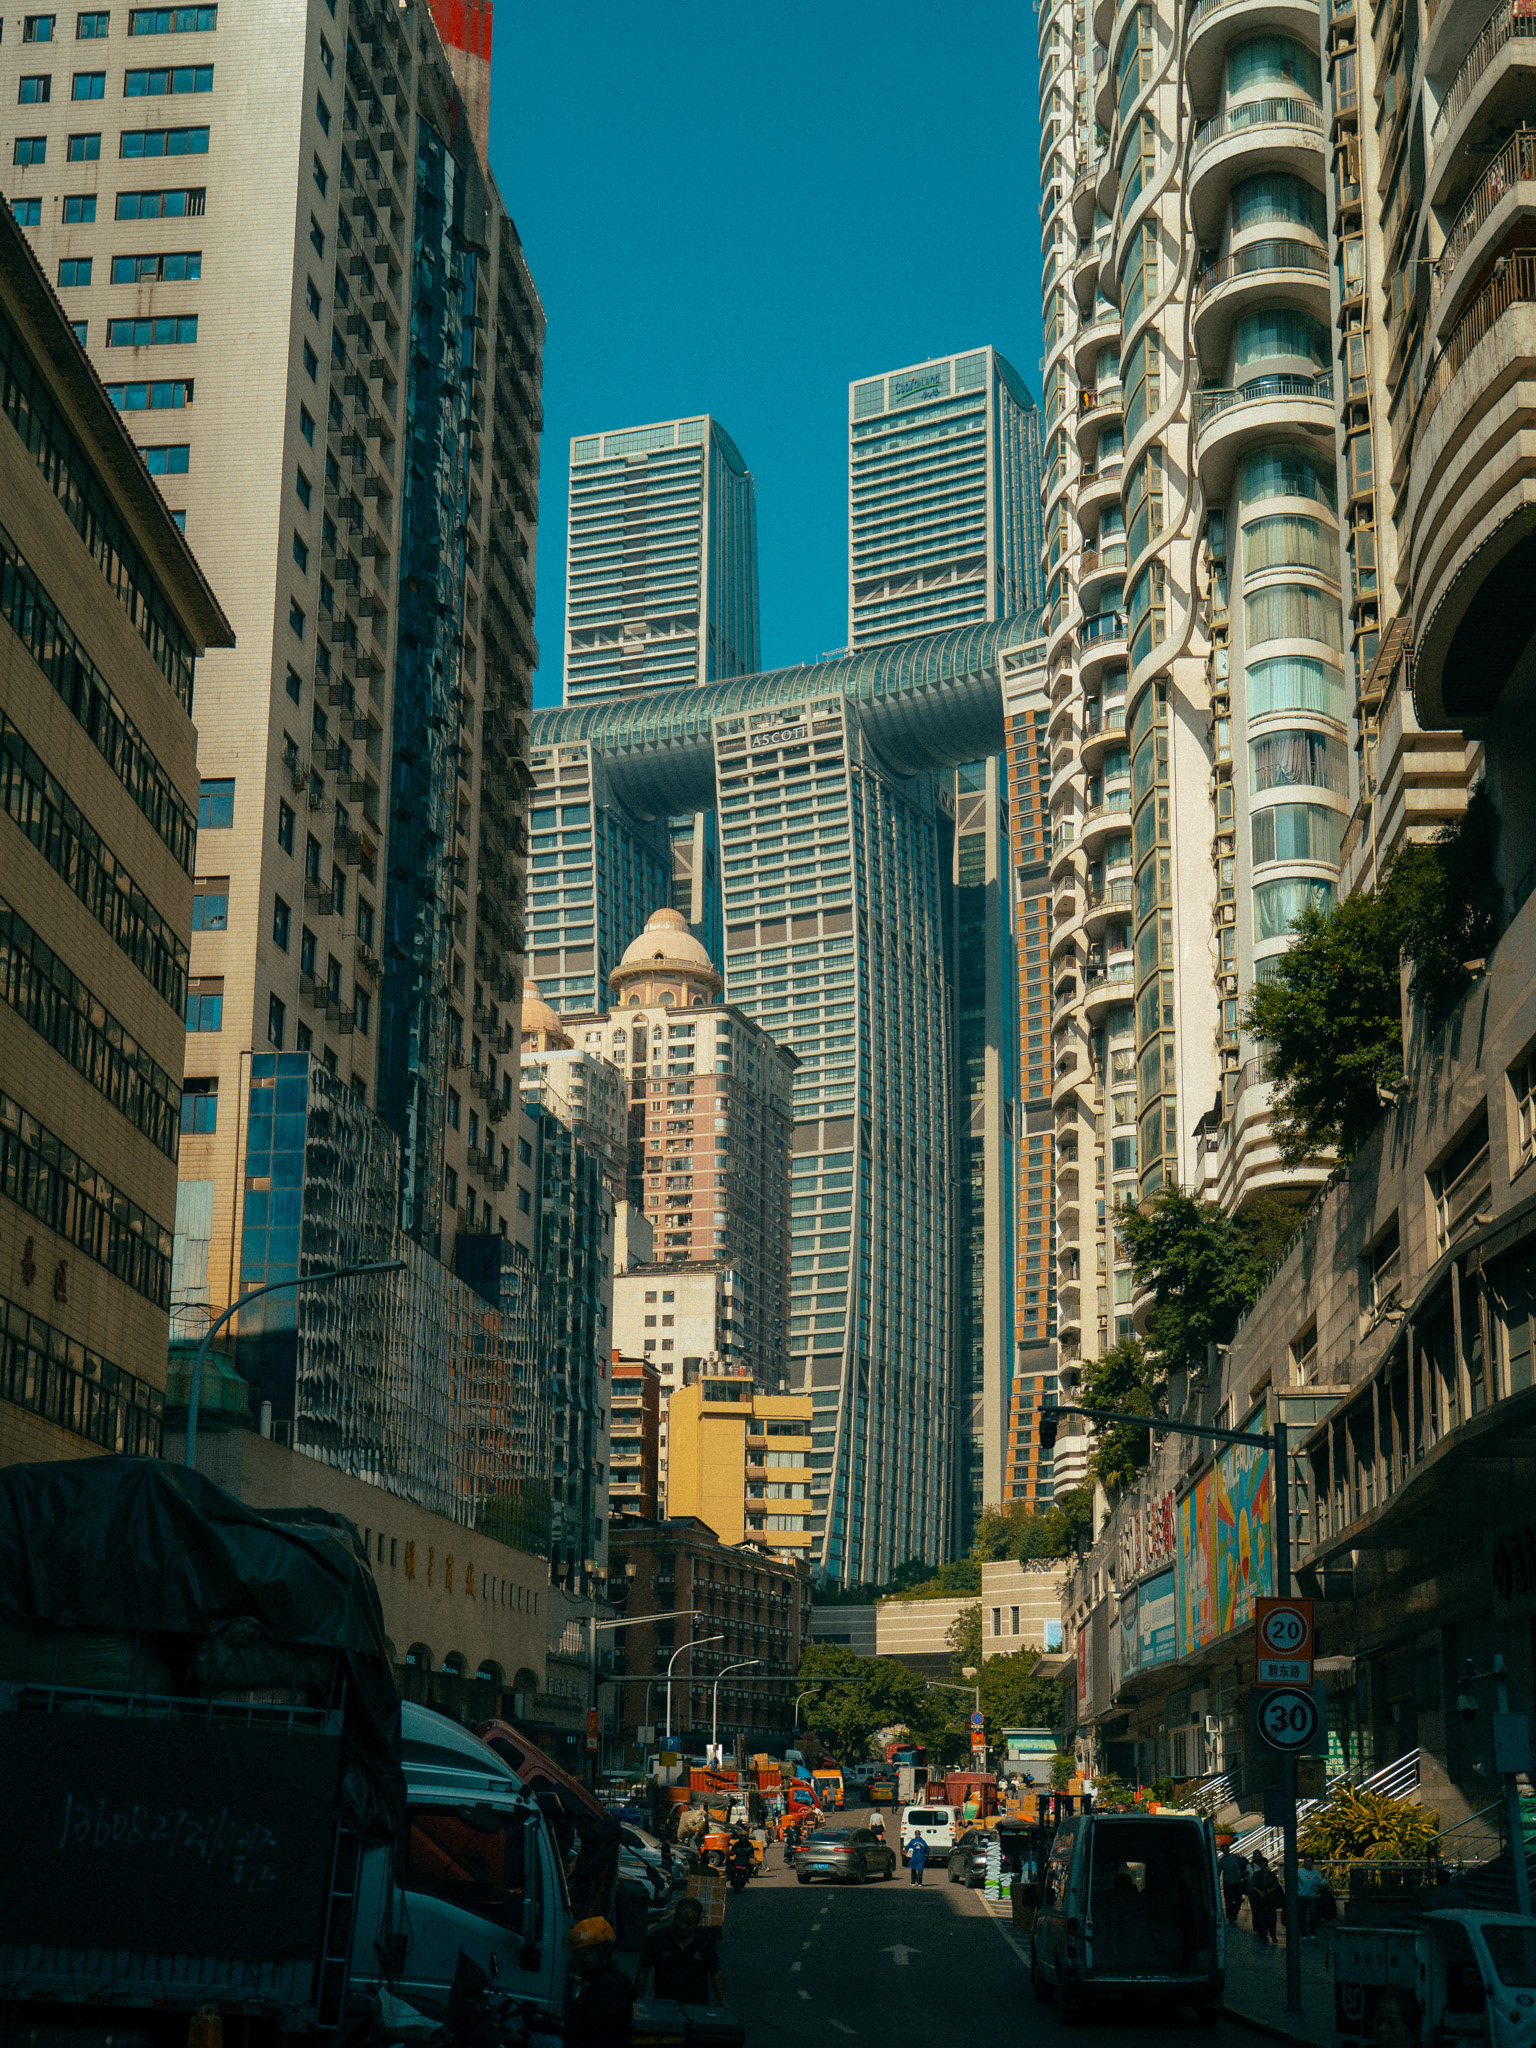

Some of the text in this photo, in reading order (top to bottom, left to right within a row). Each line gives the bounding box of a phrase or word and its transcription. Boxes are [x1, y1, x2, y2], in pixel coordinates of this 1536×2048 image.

[895, 373, 940, 395] CapitaLand
[752, 726, 807, 747] ASCOTT
[1272, 1621, 1299, 1639] 20
[1268, 1664, 1300, 1678] 朝东路
[1270, 1705, 1307, 1732] 30
[666, 1738, 674, 1750] P
